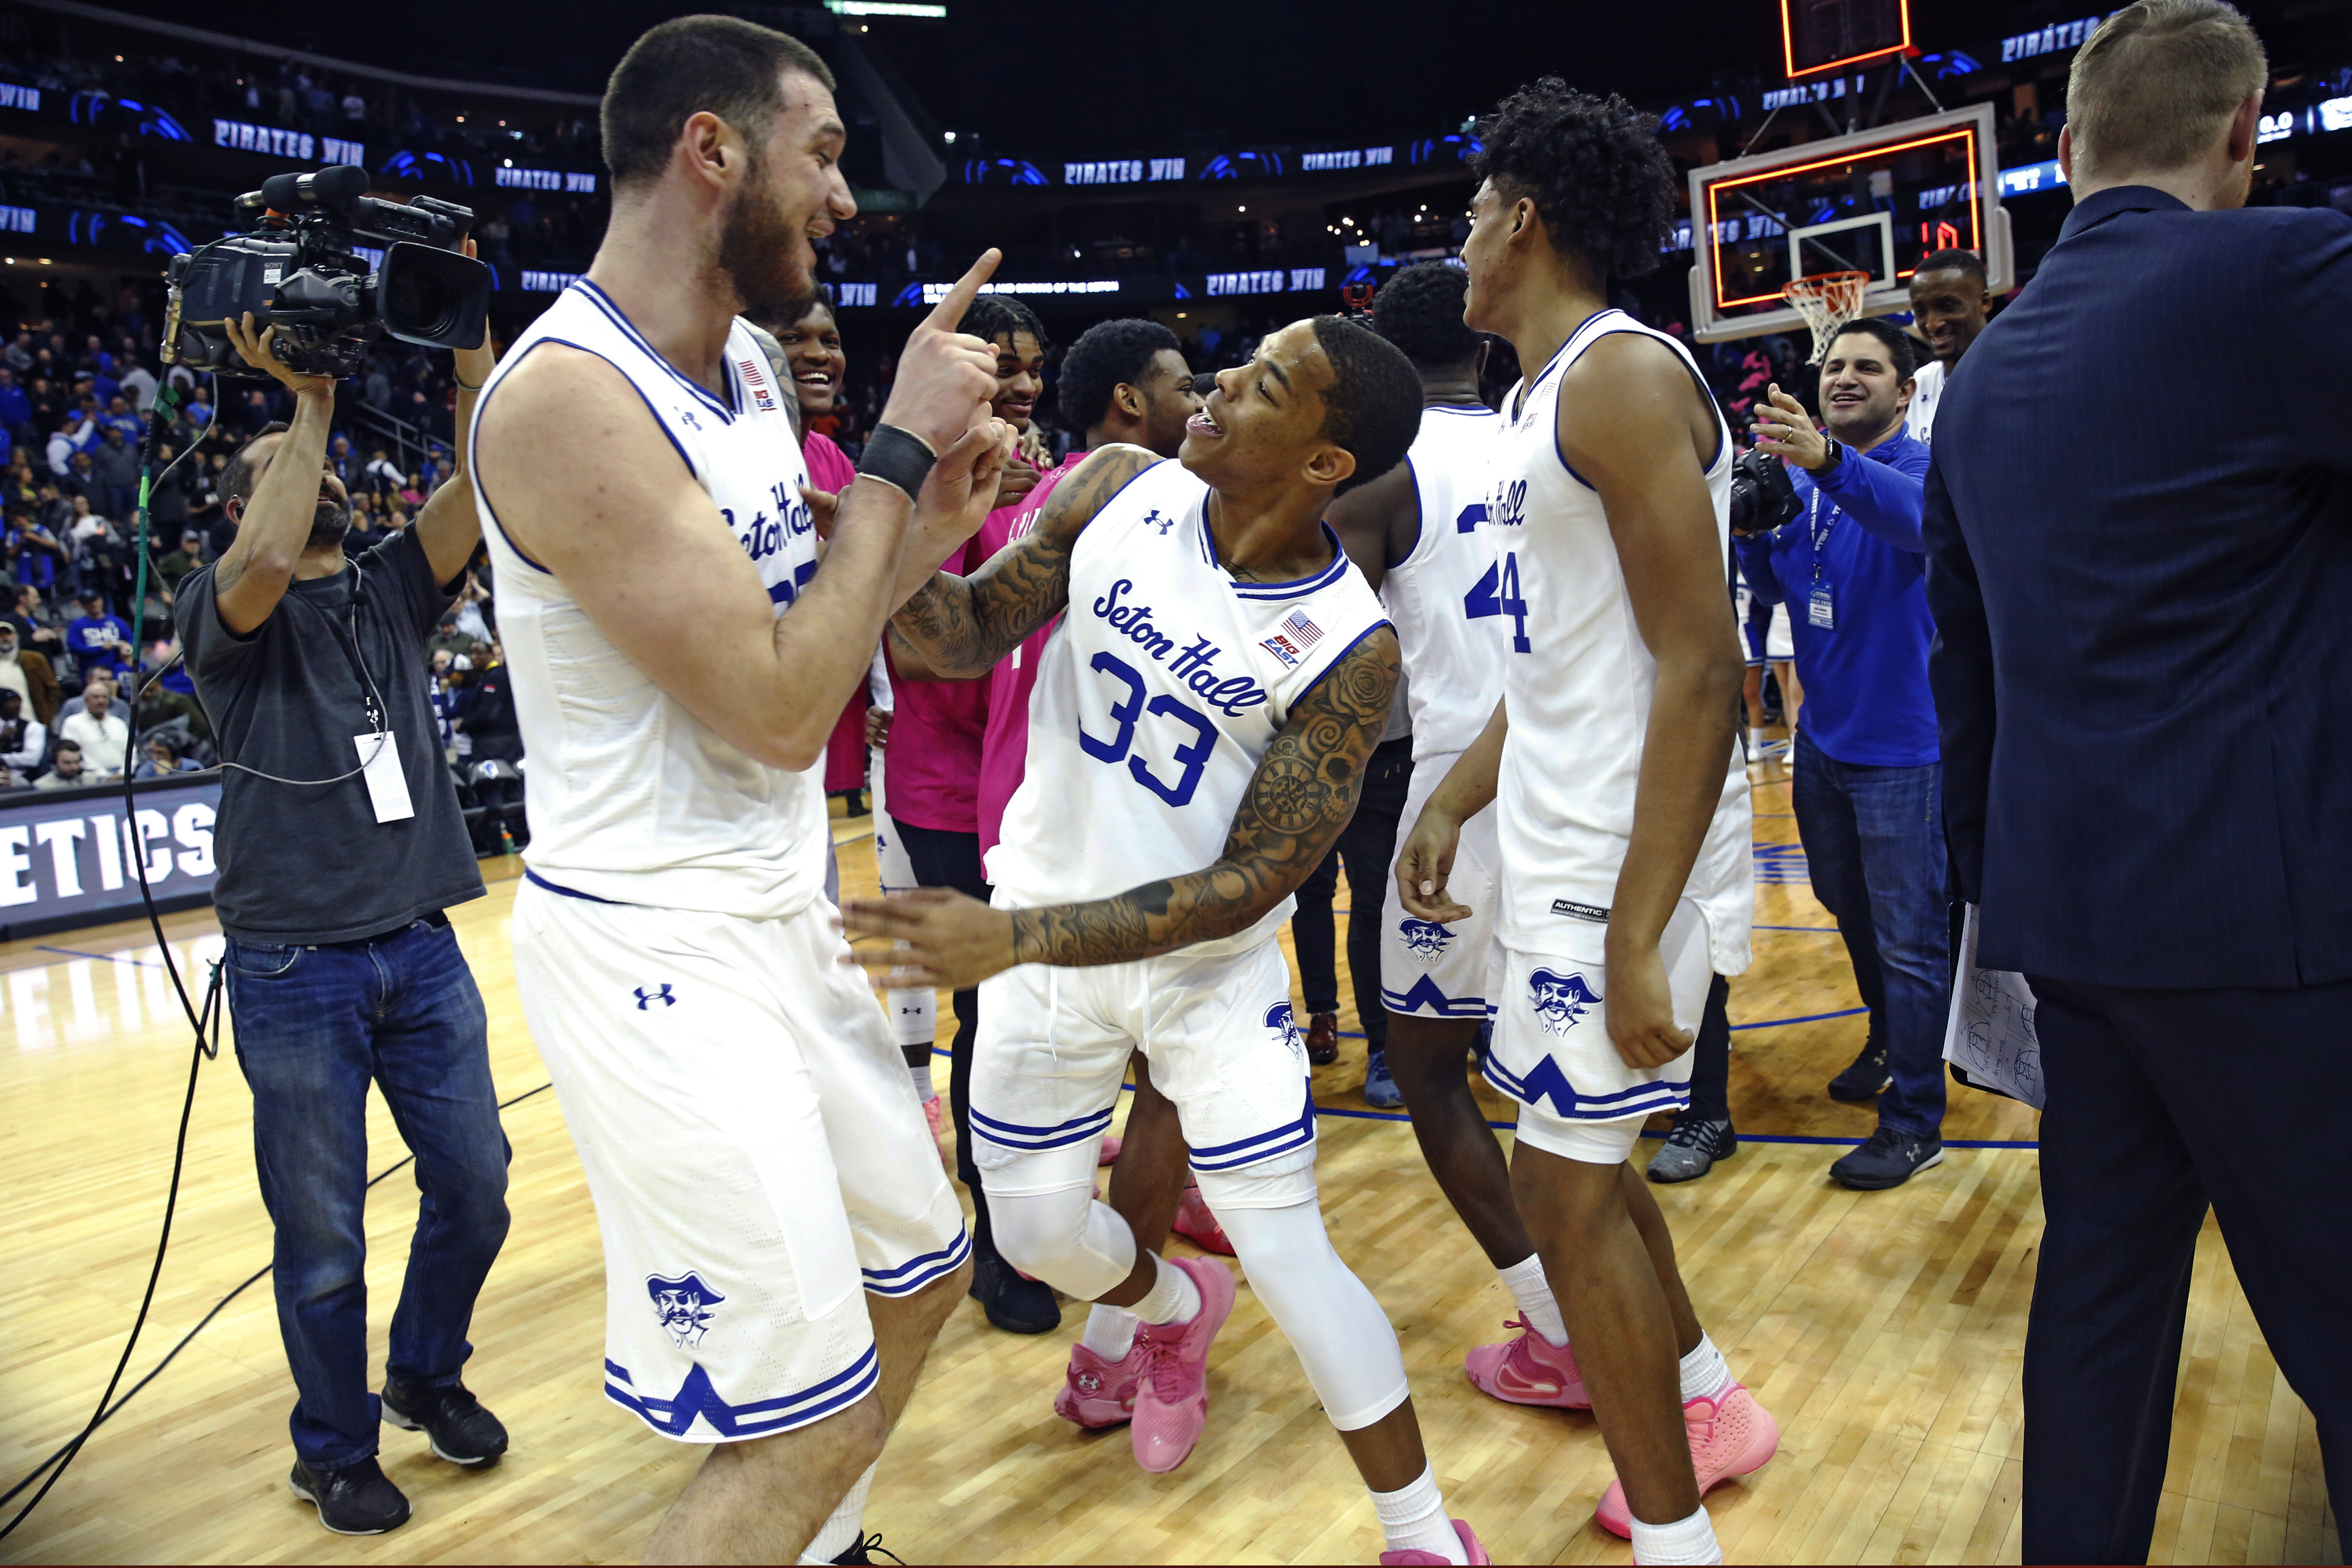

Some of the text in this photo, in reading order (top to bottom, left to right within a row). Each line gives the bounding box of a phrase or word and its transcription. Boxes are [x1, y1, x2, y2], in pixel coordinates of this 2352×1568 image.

[213, 119, 314, 160] PIRATES
[1064, 160, 1143, 185] PIRATES
[1302, 150, 1361, 171] PIRATES
[495, 167, 562, 190] PIRATES
[1206, 270, 1285, 296] PIRATES
[1093, 579, 1267, 717] Seton Hall
[1264, 638, 1299, 664] EAST
[1273, 634, 1300, 655] BIG
[1077, 651, 1219, 807] 33
[1555, 901, 1603, 917] AUTHENTIC
